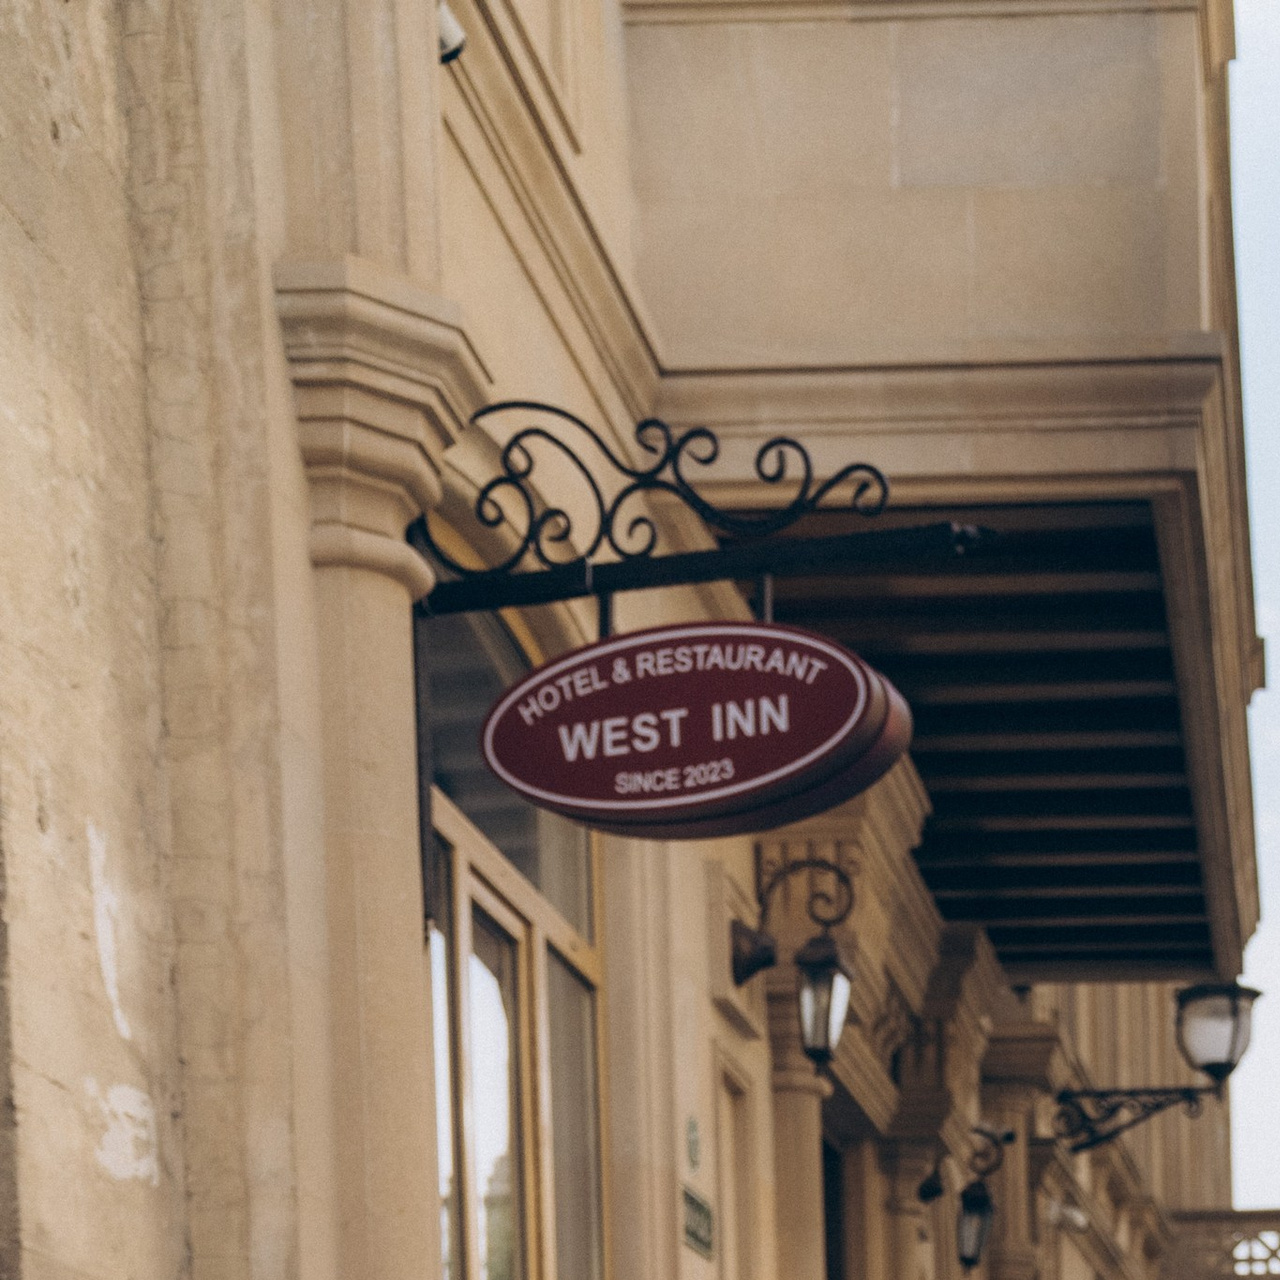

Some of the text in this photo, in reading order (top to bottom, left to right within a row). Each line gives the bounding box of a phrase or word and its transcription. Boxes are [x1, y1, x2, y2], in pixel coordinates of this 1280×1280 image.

[517, 644, 827, 725] HOTEL & RESTAURANT
[558, 694, 790, 763] WEST INN
[615, 758, 735, 795] SINCE 2023
